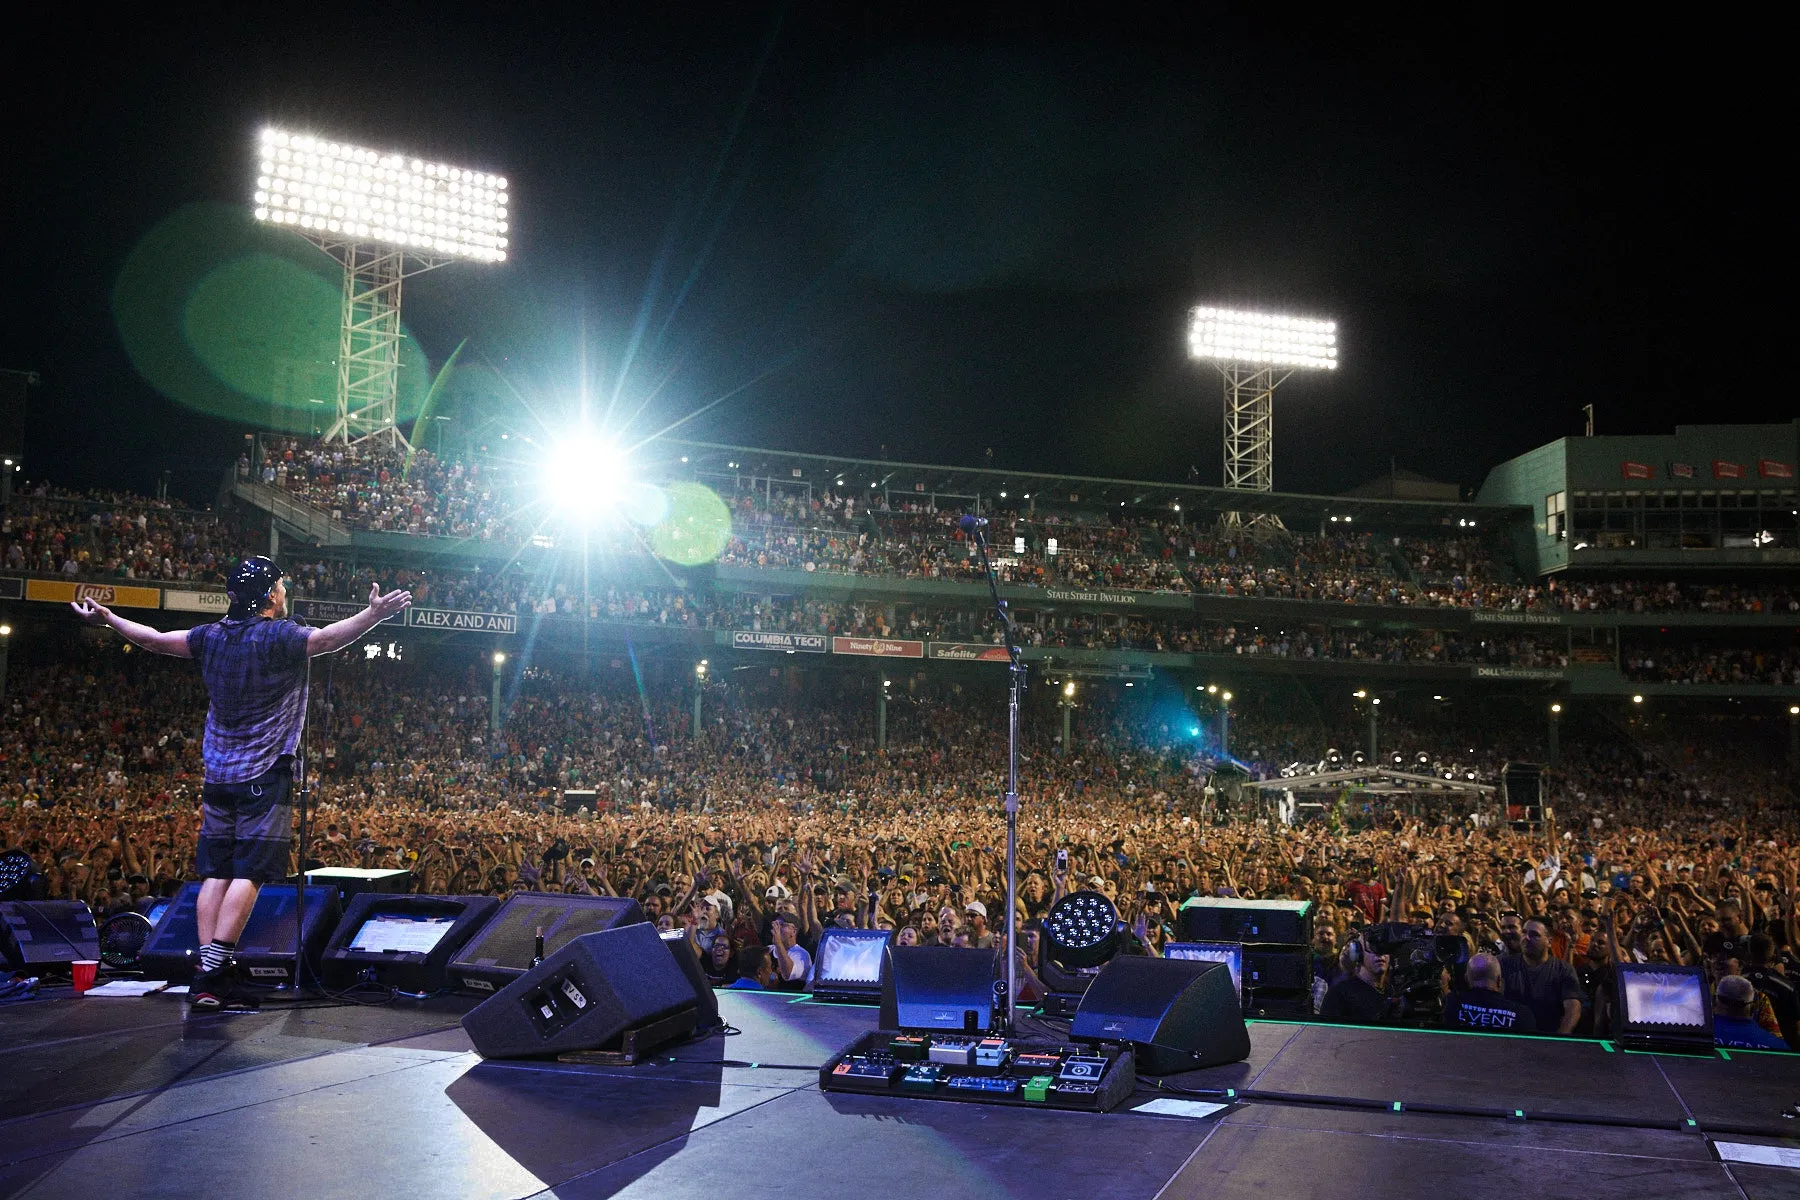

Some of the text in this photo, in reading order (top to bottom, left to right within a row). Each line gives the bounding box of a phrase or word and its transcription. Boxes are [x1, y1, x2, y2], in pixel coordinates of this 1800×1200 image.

[77, 584, 114, 602] Lay's
[1047, 589, 1136, 603] STATE STREET PAVILION
[416, 611, 511, 631] ALEX AND ANI
[1475, 612, 1561, 623] STATE STREET PAVILION
[735, 633, 822, 647] COLUMBIA TECH
[850, 642, 873, 652] Ninety
[886, 643, 903, 652] Nine
[937, 649, 977, 659] Safelite
[1459, 1010, 1516, 1028] EVENT
[1488, 1008, 1517, 1018] STRONG
